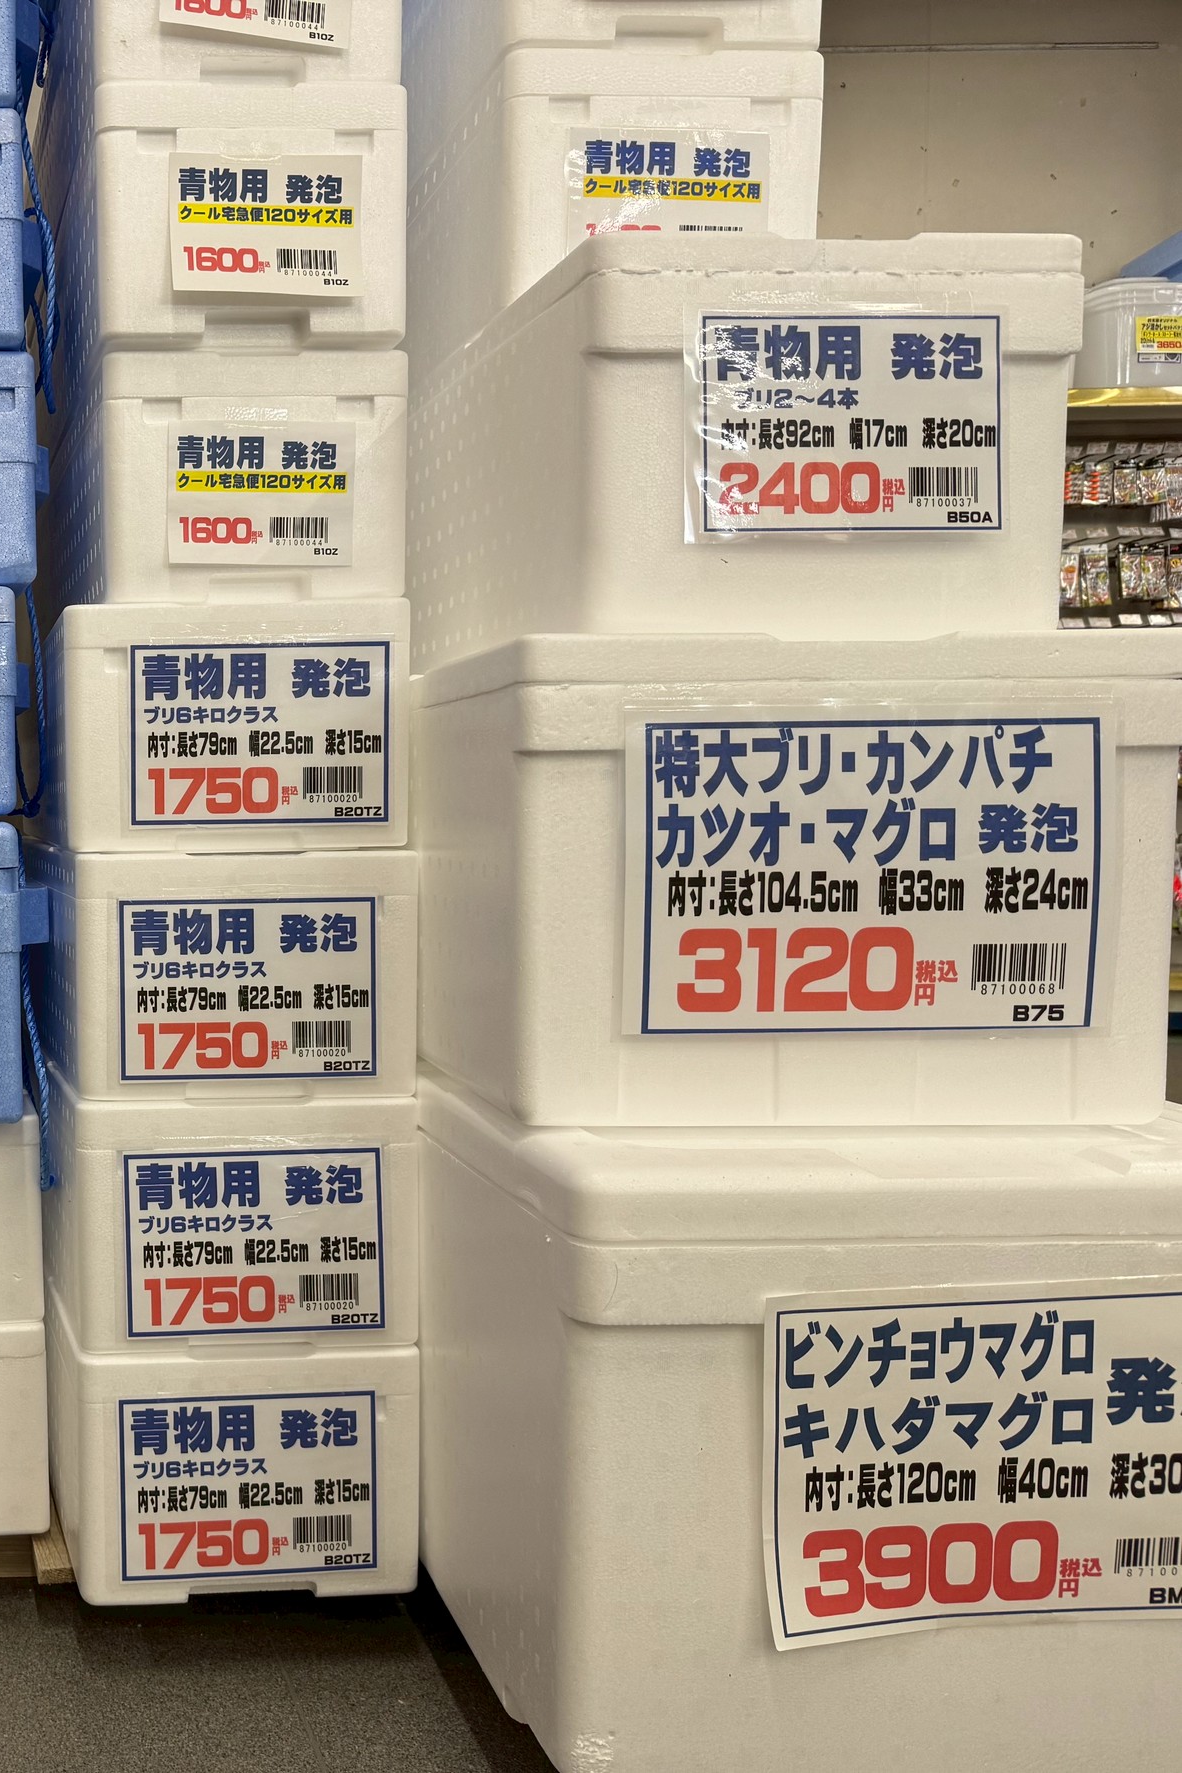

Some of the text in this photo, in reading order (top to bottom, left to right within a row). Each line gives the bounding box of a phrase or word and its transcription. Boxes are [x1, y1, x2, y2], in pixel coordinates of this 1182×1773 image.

[584, 139, 751, 178] 青物用 発泡
[178, 167, 343, 204] 青物用 発泡
[179, 206, 353, 225] クール宅急便120サイズ用
[183, 246, 259, 273] 1600
[284, 269, 332, 277] 87100044
[323, 278, 349, 286] B10Z
[714, 324, 983, 381] 青物用 発泡
[849, 418, 908, 450] 幅17cm
[922, 417, 996, 448] 深さ20cm
[177, 434, 337, 470] 青物用 発泡
[177, 473, 347, 490] クール宅急便120サイズ用
[719, 461, 881, 515] 2400
[916, 497, 972, 508] 87100037
[947, 511, 993, 524] B50A
[179, 516, 252, 544] 1600
[313, 548, 339, 556] B10Z
[141, 653, 371, 701] 青物用 発泡
[143, 705, 279, 725] ブリ6キロクラス
[248, 730, 314, 758] 幅22.5cm
[324, 728, 382, 755] 深さ15cm
[654, 724, 1053, 798] 特大ブリ・カンパチ
[147, 766, 279, 815] 1750
[309, 794, 358, 803] 87100020
[655, 797, 1079, 869] カツオ・マグロ 発泡
[878, 868, 965, 916] 幅33cm
[984, 866, 1089, 915] 深さ24cm
[130, 908, 358, 956] 青物用 発泡
[132, 960, 267, 980] ブリ6キロクラス
[676, 926, 915, 1013] 3120
[237, 985, 302, 1012] 幅22.5cm
[313, 983, 369, 1010] 深さ15cm
[980, 983, 1055, 996] 87100068
[1012, 1004, 1065, 1022] B75
[137, 1021, 269, 1070] 1750
[135, 1160, 363, 1211] 青物用 発泡
[138, 1214, 274, 1235] ブリ6キロクラス
[244, 1238, 309, 1266] 幅22.5cm
[319, 1236, 377, 1263] 深さ15cm
[143, 1275, 276, 1326] 1750
[785, 1309, 1095, 1390] ビンチョウマグロ
[1106, 1356, 1182, 1426] 発
[130, 1404, 358, 1456] 青物用 発泡
[782, 1390, 1094, 1460] キハダマグロ
[132, 1458, 268, 1479] ブリ6キロクラス
[997, 1456, 1089, 1504] 幅40cm
[238, 1482, 303, 1510] 幅22.5cm
[314, 1478, 370, 1506] 深さ15cm
[138, 1518, 269, 1570] 1750
[802, 1520, 1059, 1618] 3900
